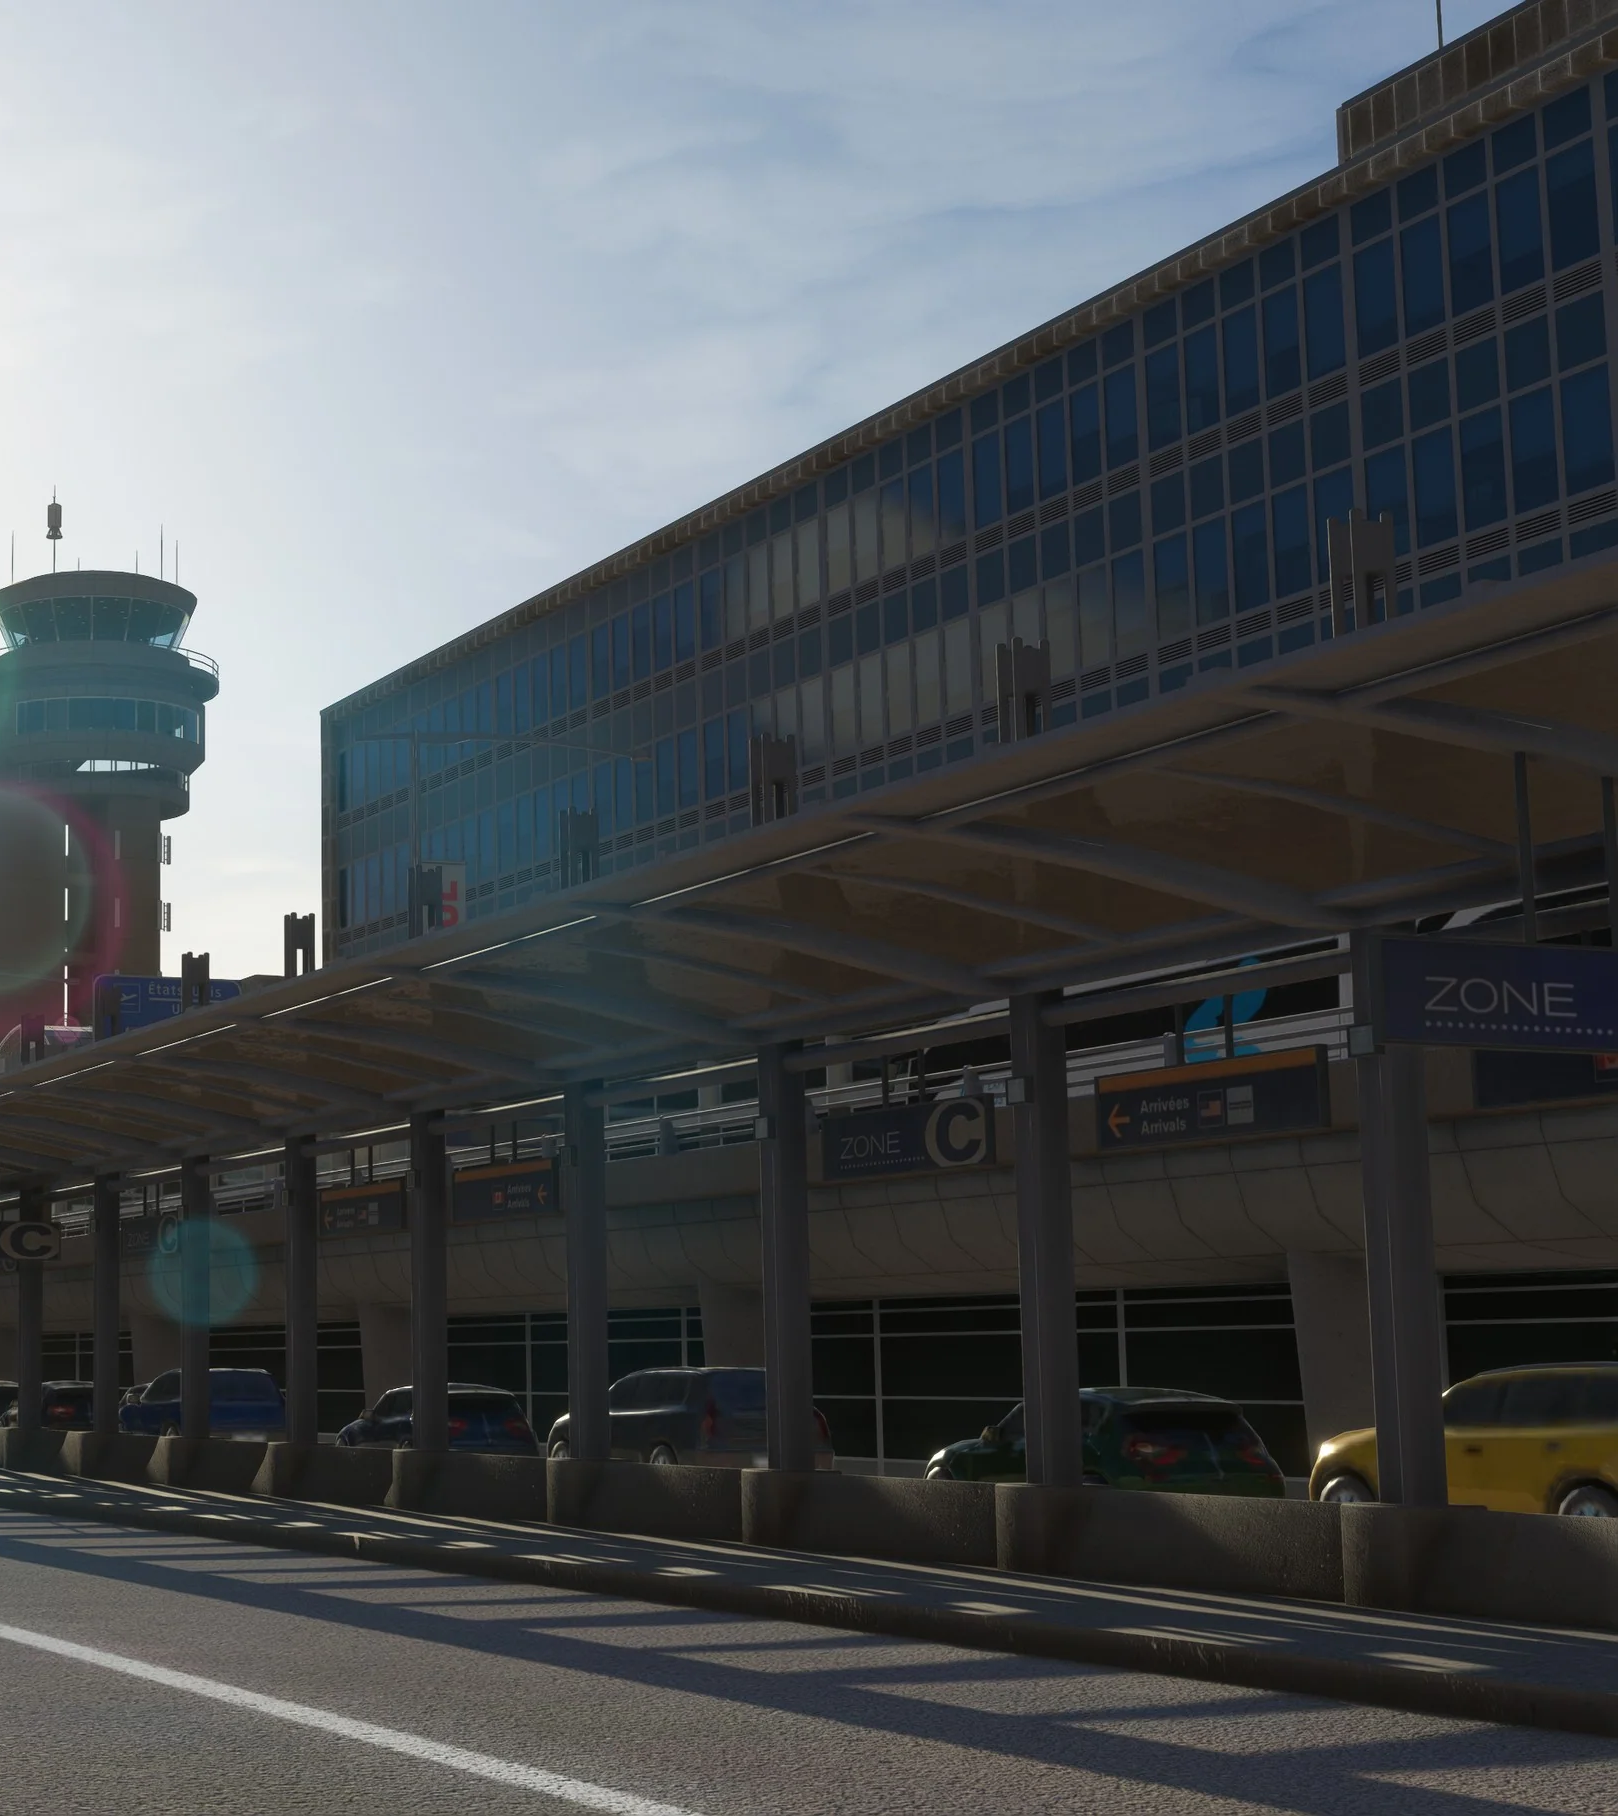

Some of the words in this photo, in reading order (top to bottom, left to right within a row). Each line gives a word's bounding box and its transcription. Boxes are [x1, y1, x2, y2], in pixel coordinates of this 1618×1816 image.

[1424, 976, 1577, 1017] ZONE
[1140, 1096, 1189, 1114] Arrivées
[840, 1130, 901, 1159] ZONE
[936, 1102, 983, 1162] C
[1140, 1116, 1187, 1135] Arrivals
[10, 1224, 53, 1257] C
